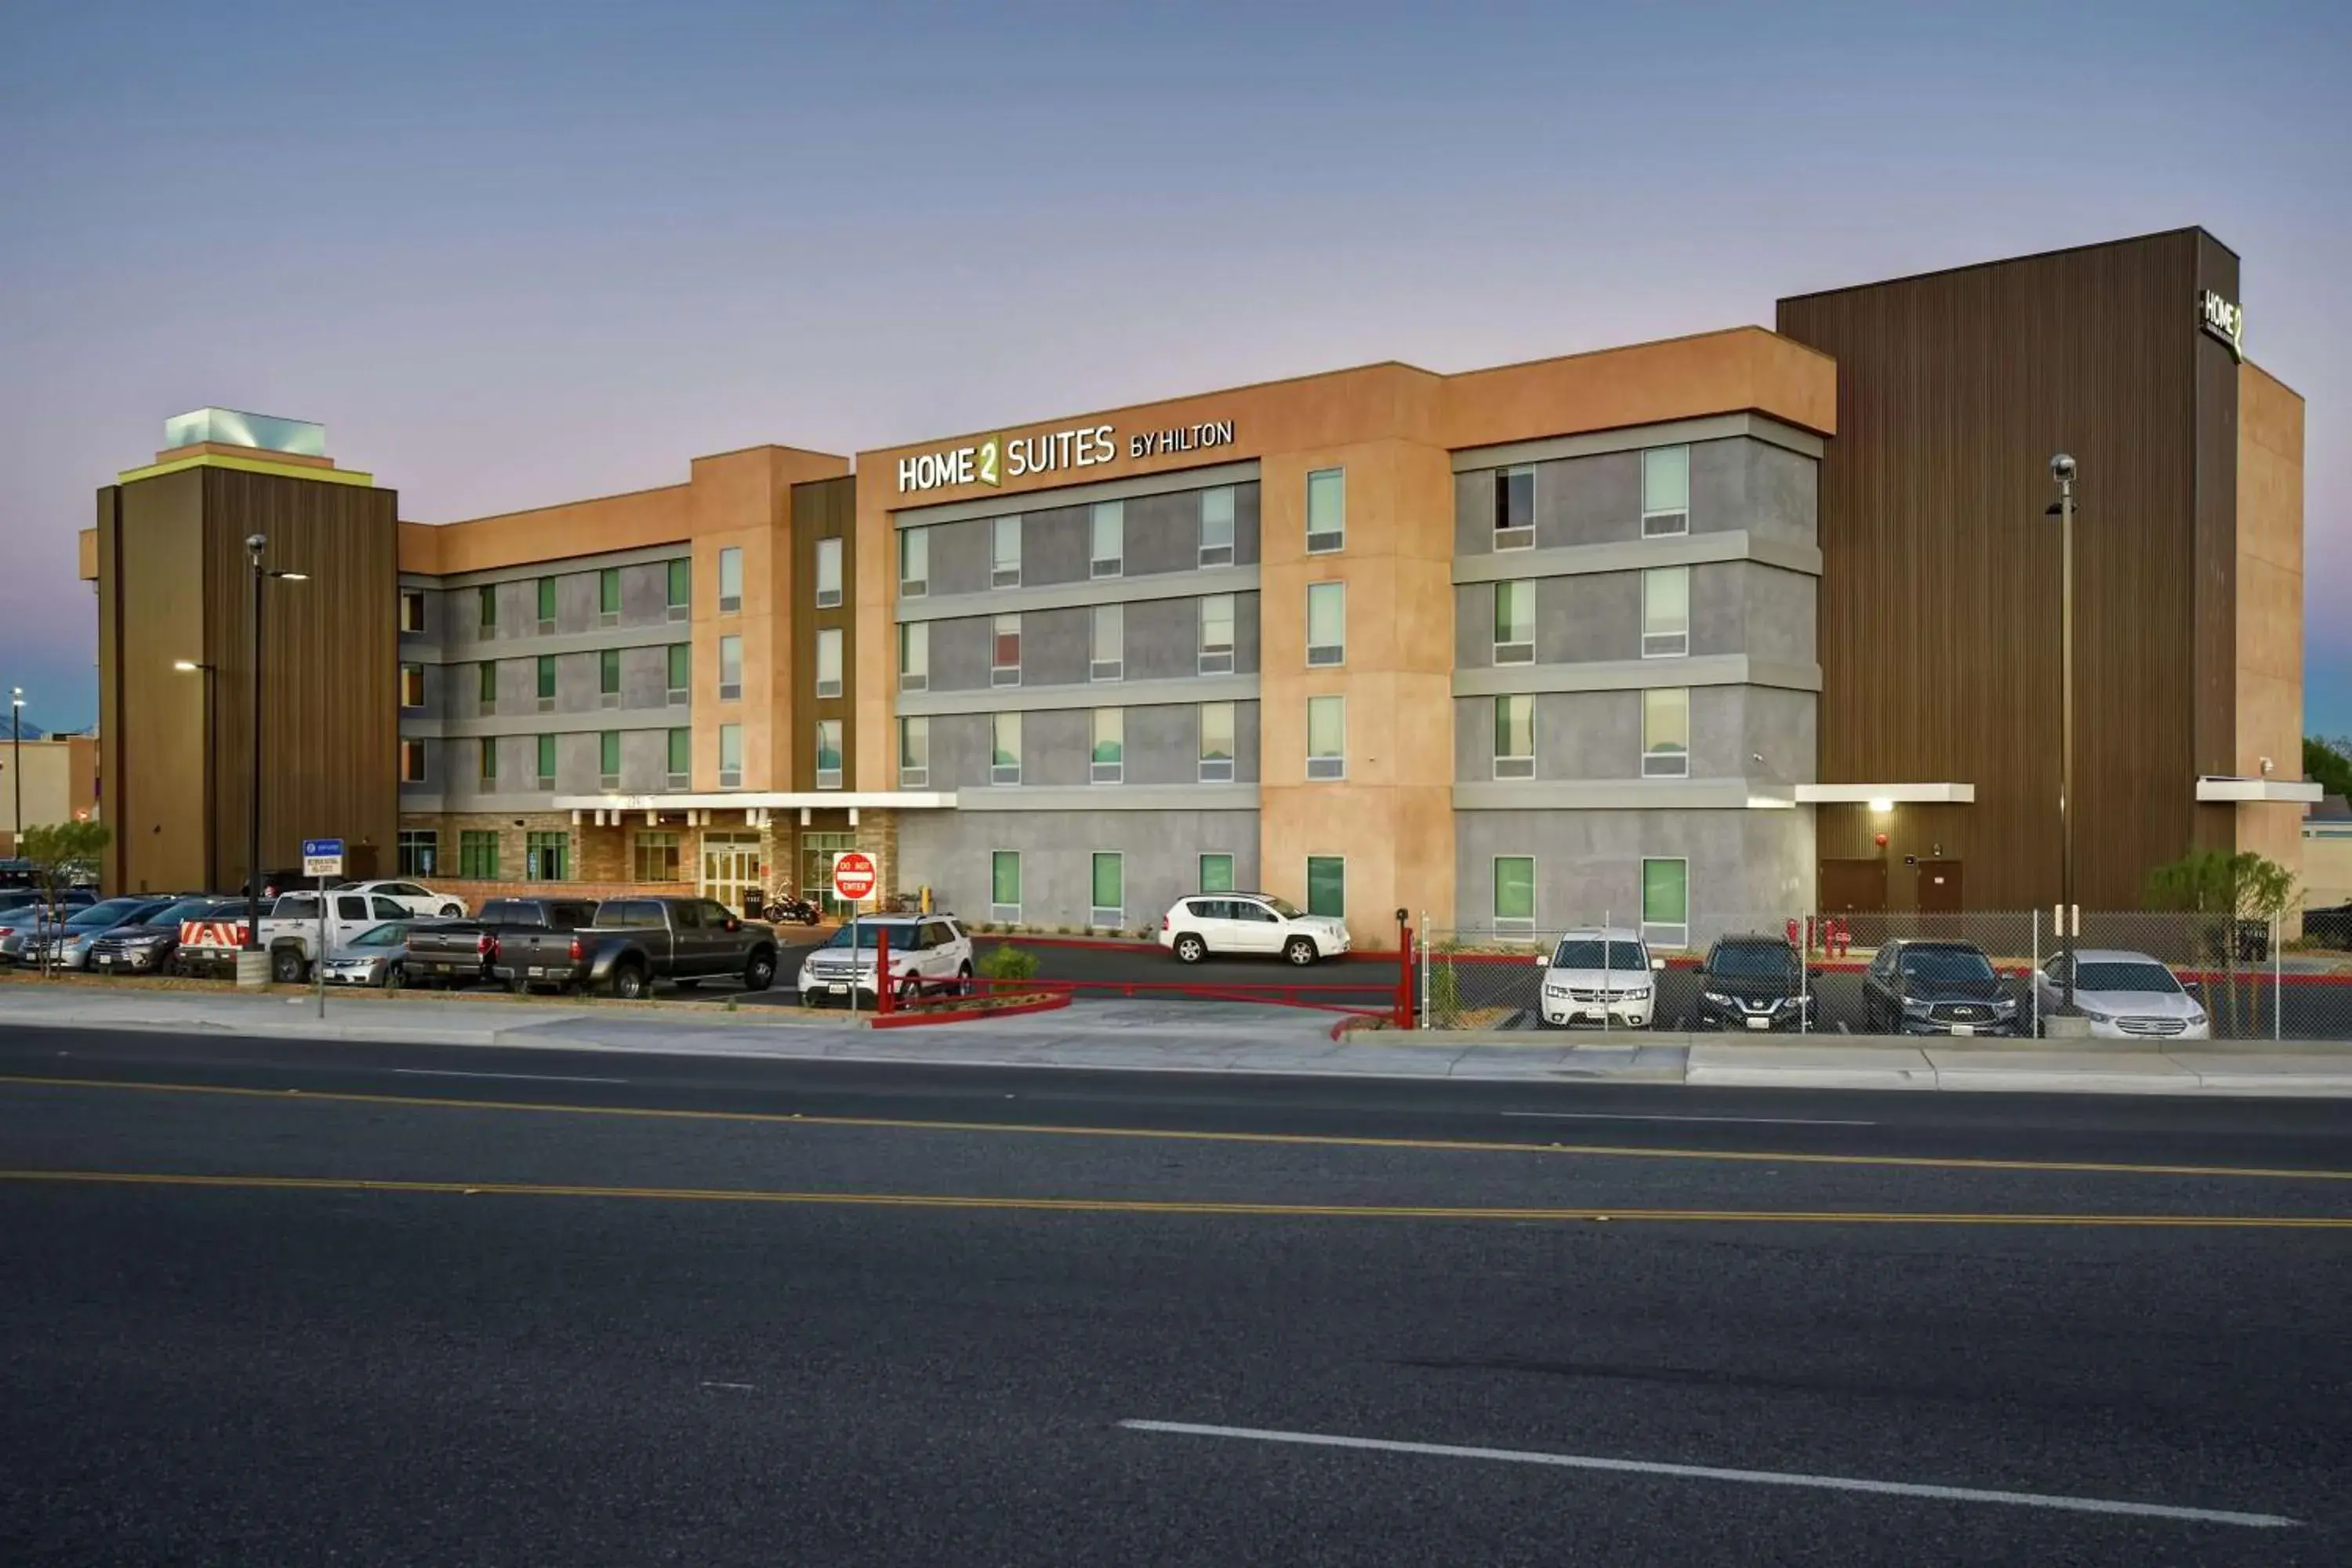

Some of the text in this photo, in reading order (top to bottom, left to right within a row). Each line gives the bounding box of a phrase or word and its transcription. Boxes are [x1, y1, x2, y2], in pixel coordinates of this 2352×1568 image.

[2205, 289, 2234, 336] HOME
[899, 419, 1233, 493] HOME 2 SUITES BY HILTON
[840, 862, 869, 870] DO NOT
[843, 882, 866, 891] ENTER
